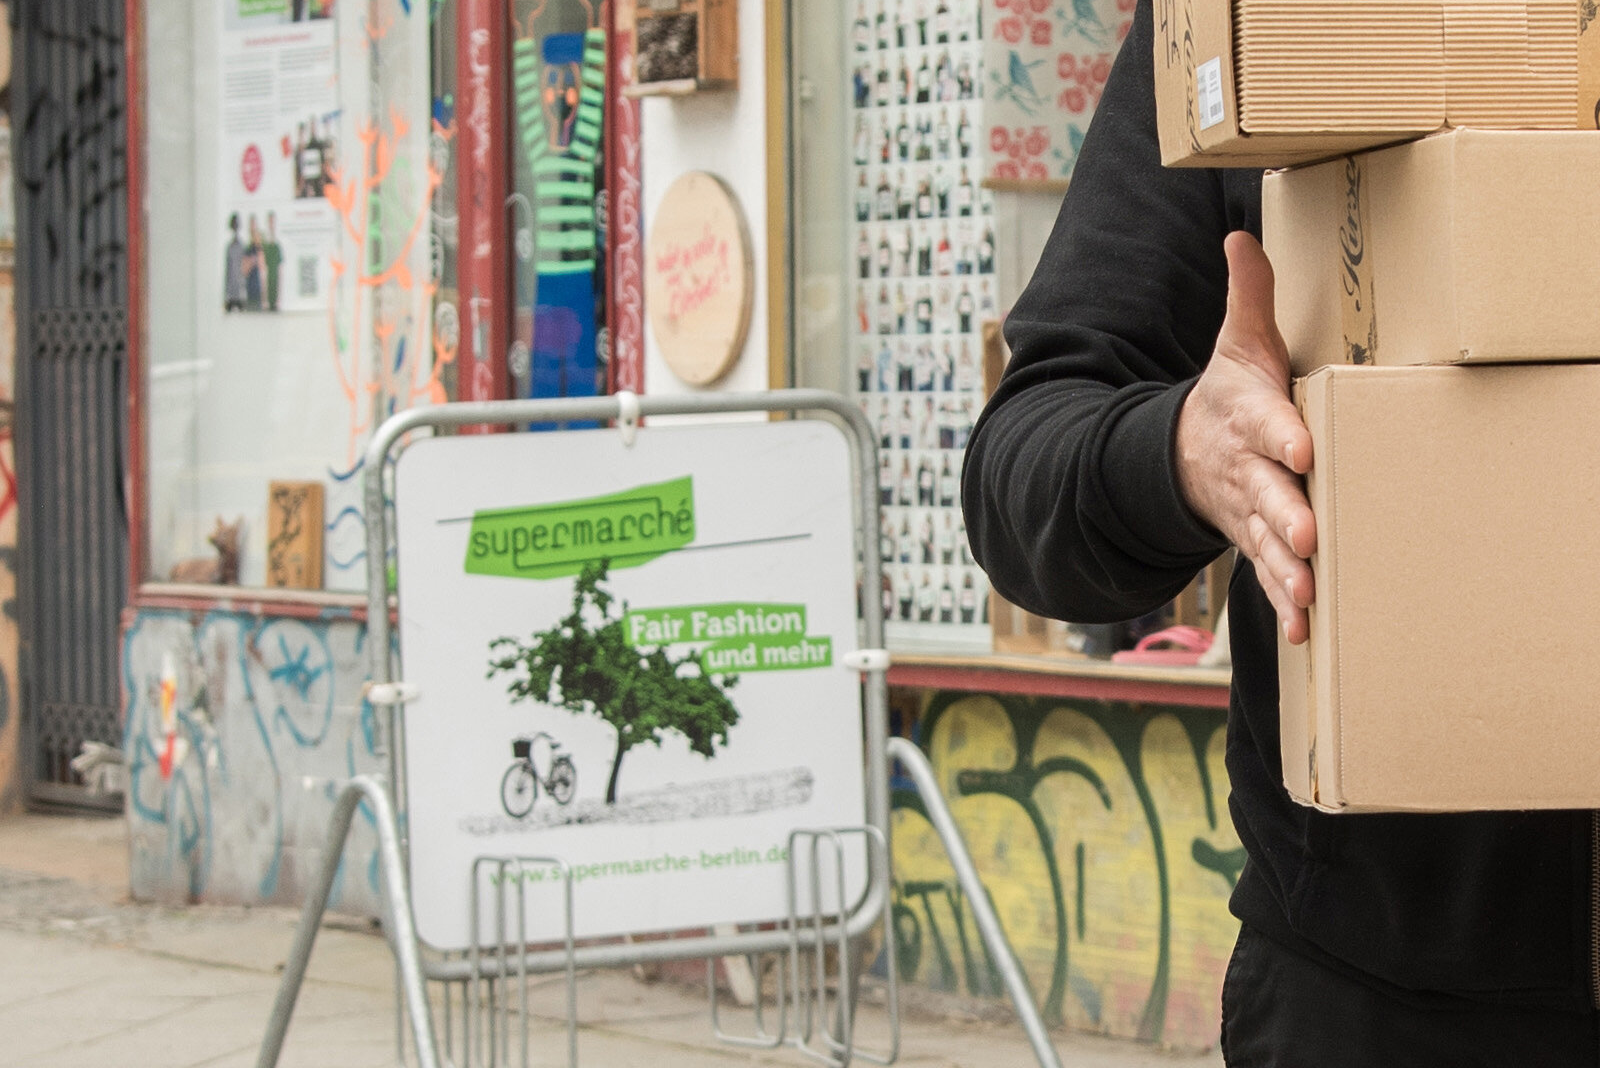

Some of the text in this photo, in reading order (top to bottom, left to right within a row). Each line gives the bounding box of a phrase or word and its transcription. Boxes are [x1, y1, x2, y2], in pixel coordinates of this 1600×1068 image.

[472, 497, 693, 570] supermarché
[629, 607, 803, 642] Fair Fashion
[706, 639, 829, 669] und mehr
